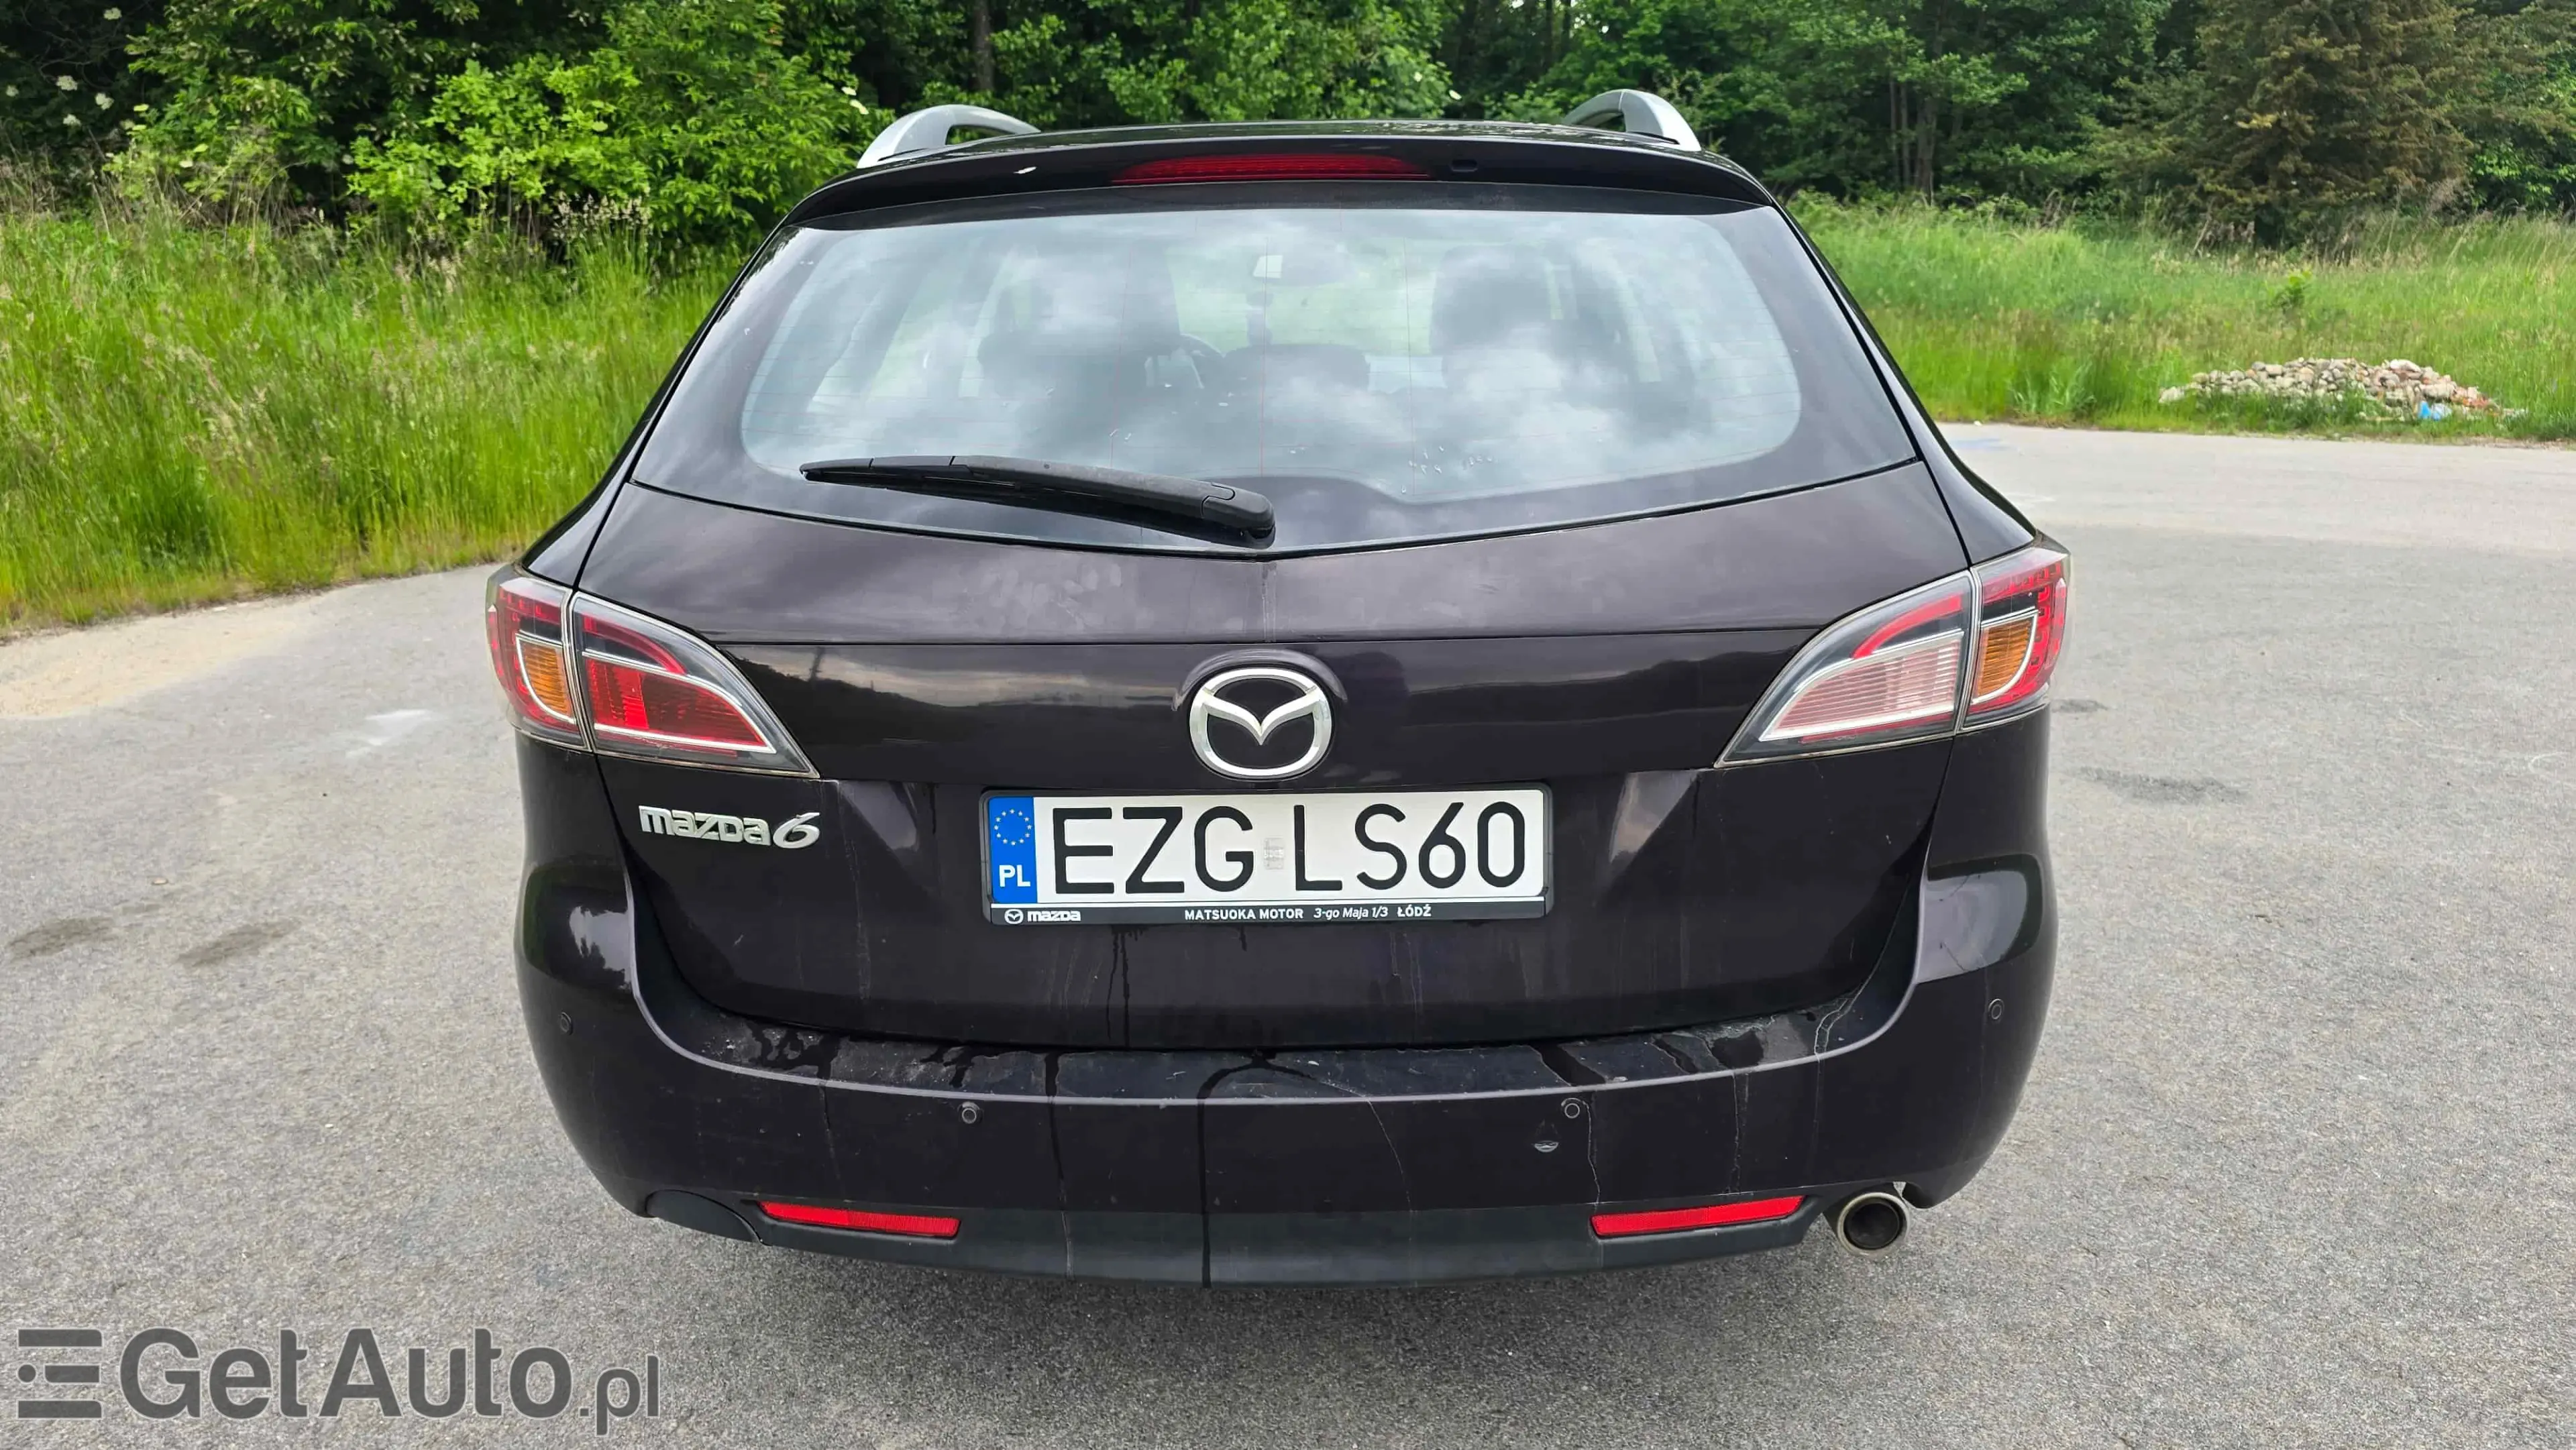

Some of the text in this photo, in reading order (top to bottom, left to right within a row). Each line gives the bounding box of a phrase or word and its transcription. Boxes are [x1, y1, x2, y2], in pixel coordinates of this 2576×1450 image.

[1053, 801, 1526, 895] EZG LS60
[999, 865, 1030, 888] PL
[1184, 903, 1432, 920] MATSUOKA MOTOR 3-go Maja 1/3 ŁÓDŹ
